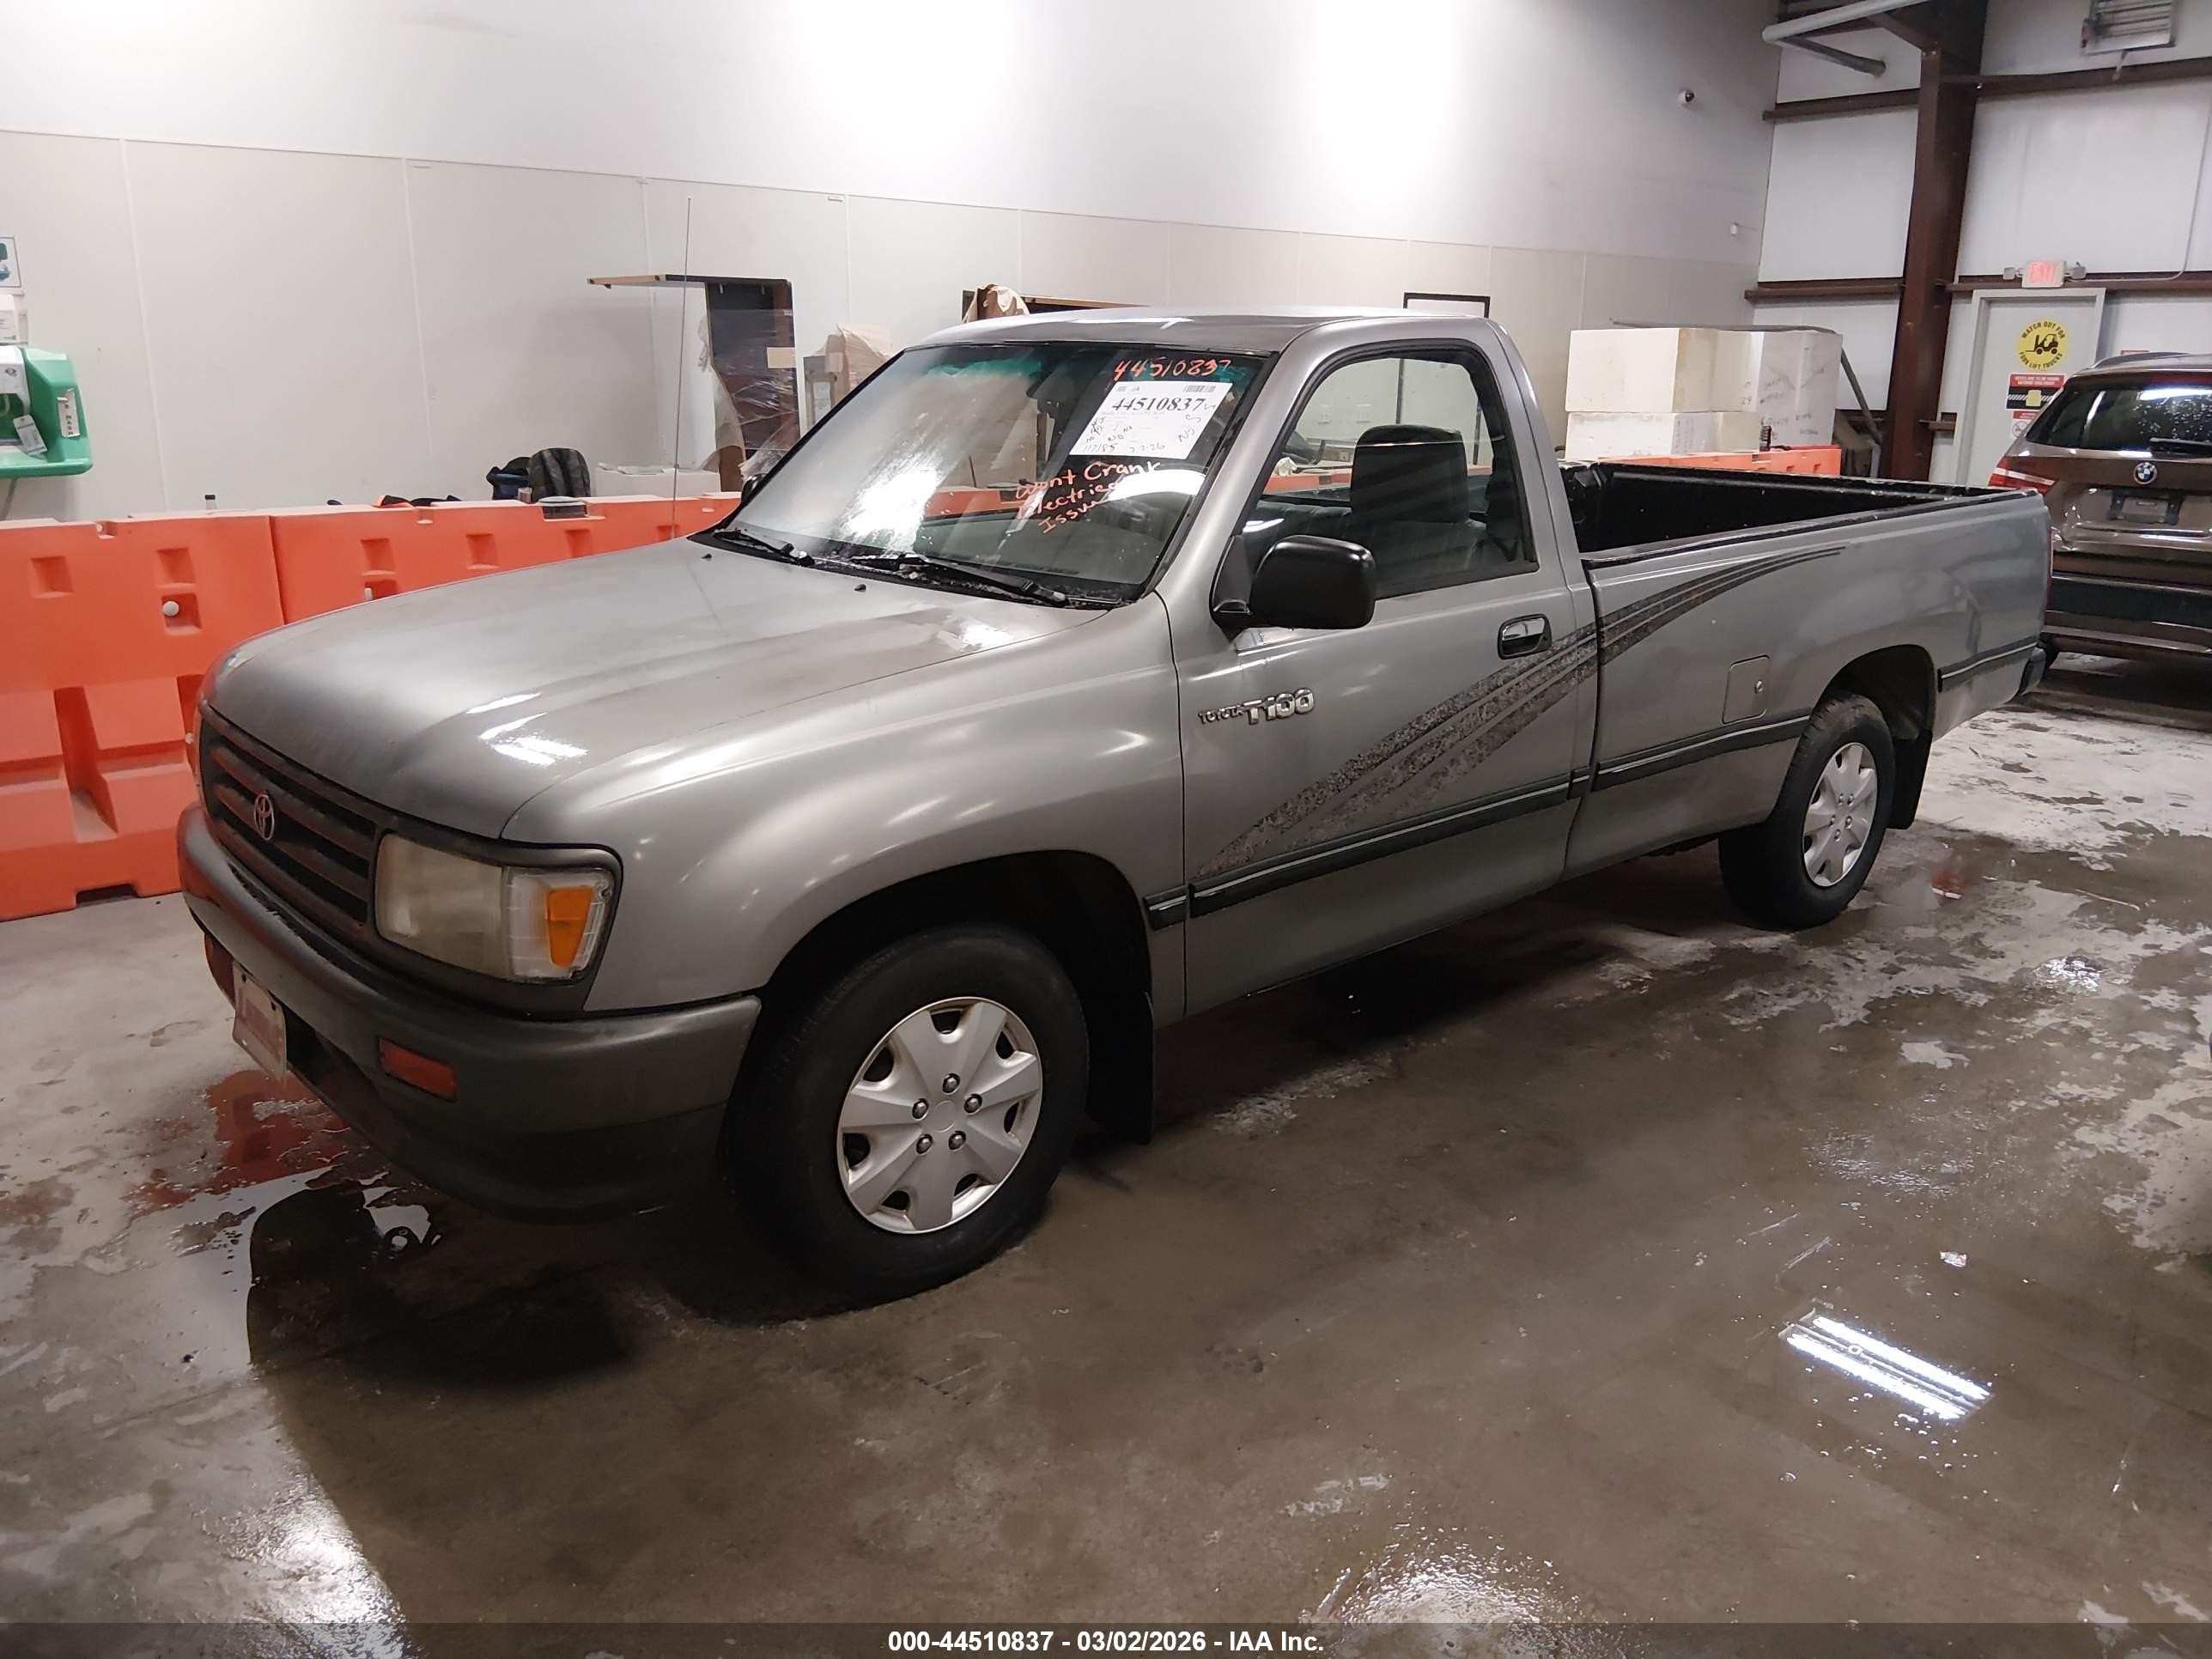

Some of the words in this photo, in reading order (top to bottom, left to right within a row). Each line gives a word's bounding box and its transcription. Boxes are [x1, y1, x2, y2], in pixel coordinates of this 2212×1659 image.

[2021, 322, 2042, 338] WATCH
[2055, 326, 2066, 339] FOR
[1114, 356, 1231, 380] 44510837
[1112, 398, 1206, 411] 44510837
[1084, 460, 1160, 481] Crank
[1243, 687, 1315, 726] T100
